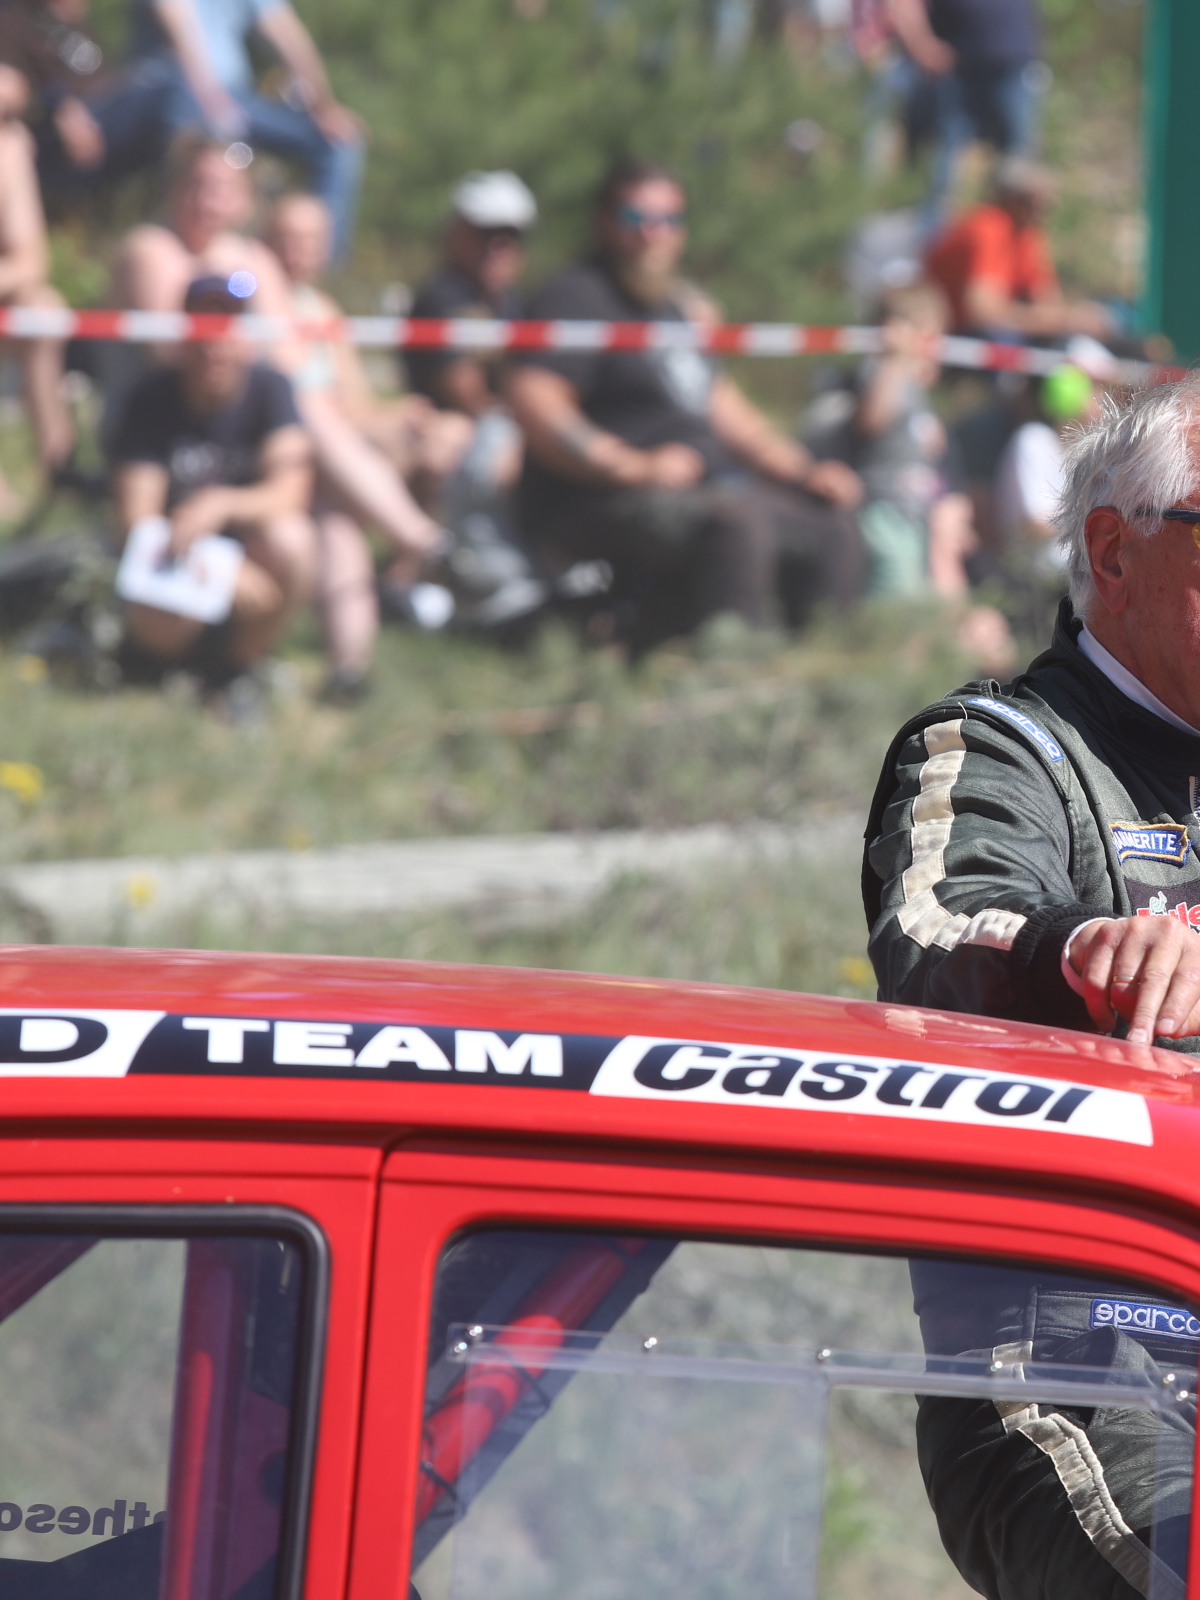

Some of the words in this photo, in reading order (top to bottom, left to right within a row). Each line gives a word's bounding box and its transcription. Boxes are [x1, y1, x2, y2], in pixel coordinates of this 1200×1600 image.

[972, 698, 1061, 759] sparco
[183, 1017, 563, 1077] TEAM
[633, 1043, 1099, 1123] Castrol
